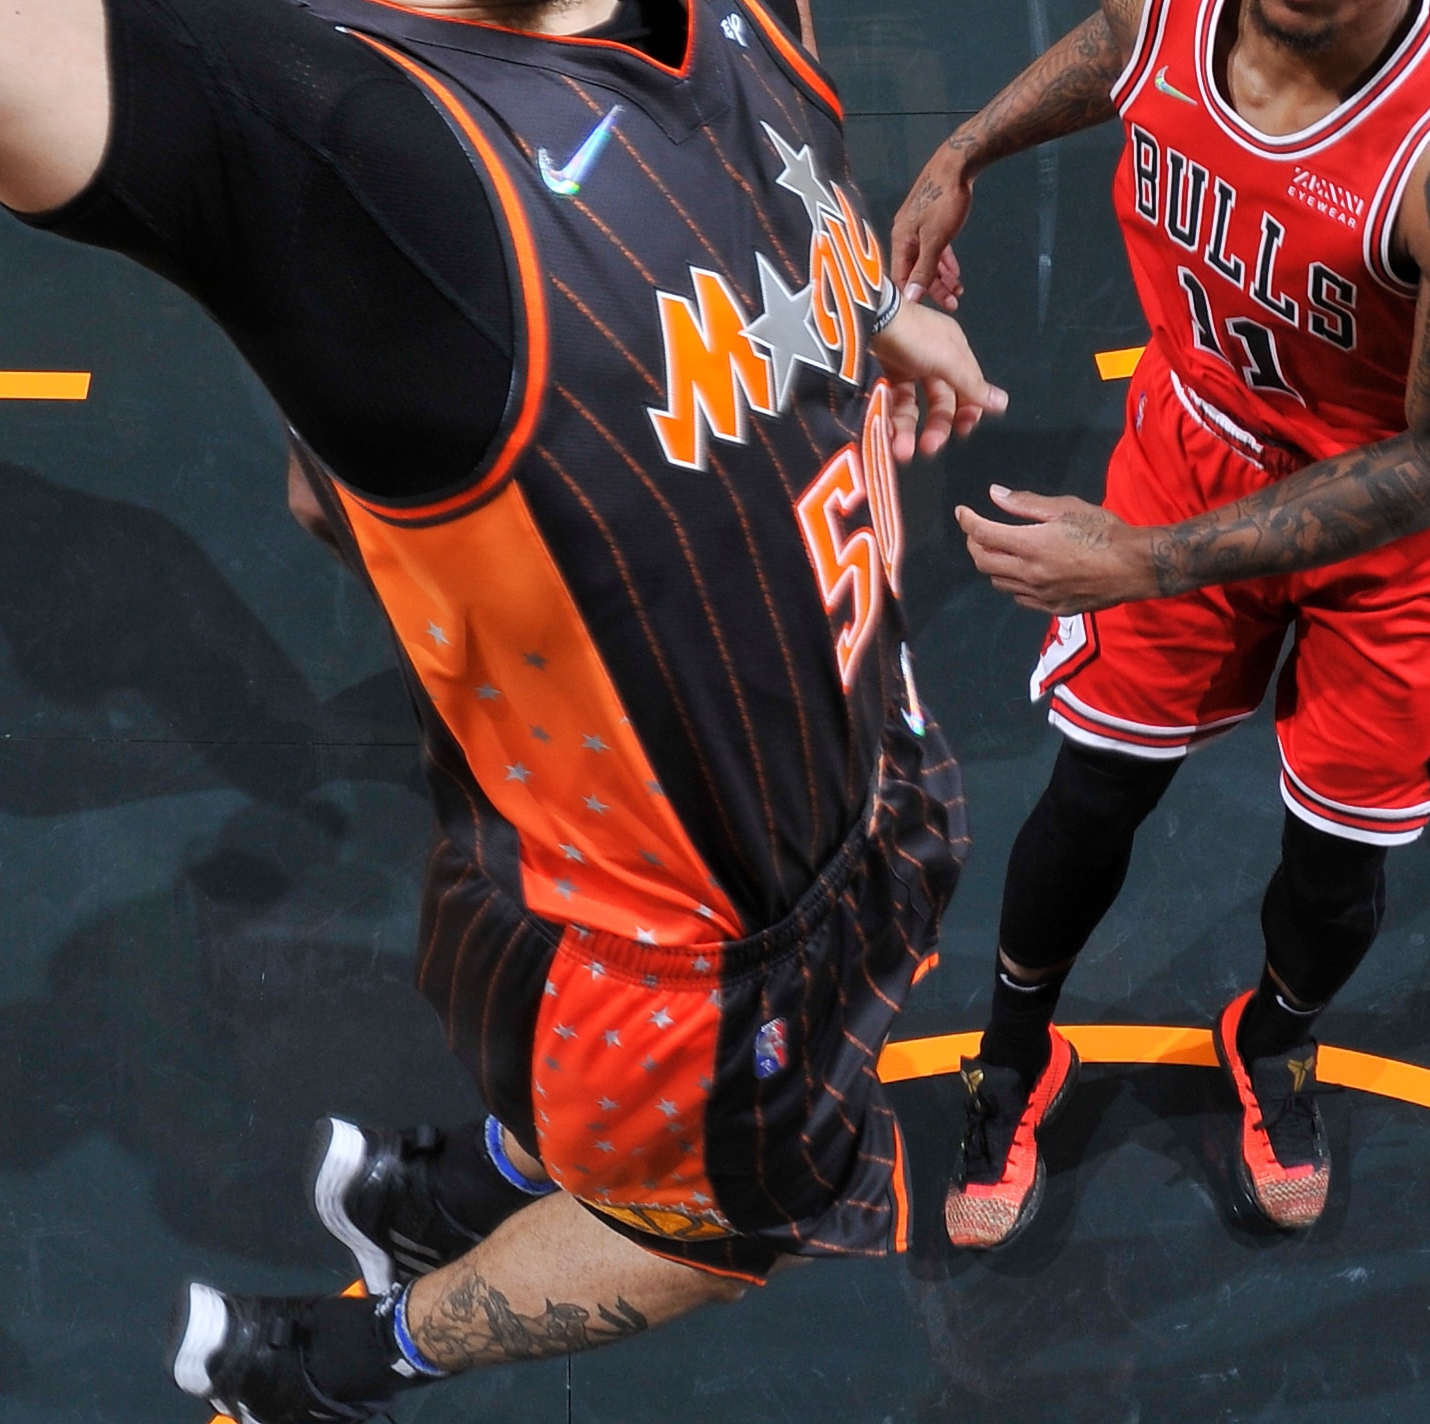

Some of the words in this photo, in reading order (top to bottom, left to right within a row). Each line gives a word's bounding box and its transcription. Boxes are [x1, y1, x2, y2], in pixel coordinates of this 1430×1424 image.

[647, 121, 884, 472] Magic
[1131, 122, 1358, 353] BULLS
[1287, 185, 1358, 229] EYEWEAR
[1177, 265, 1307, 409] 11
[794, 378, 904, 692] 50
